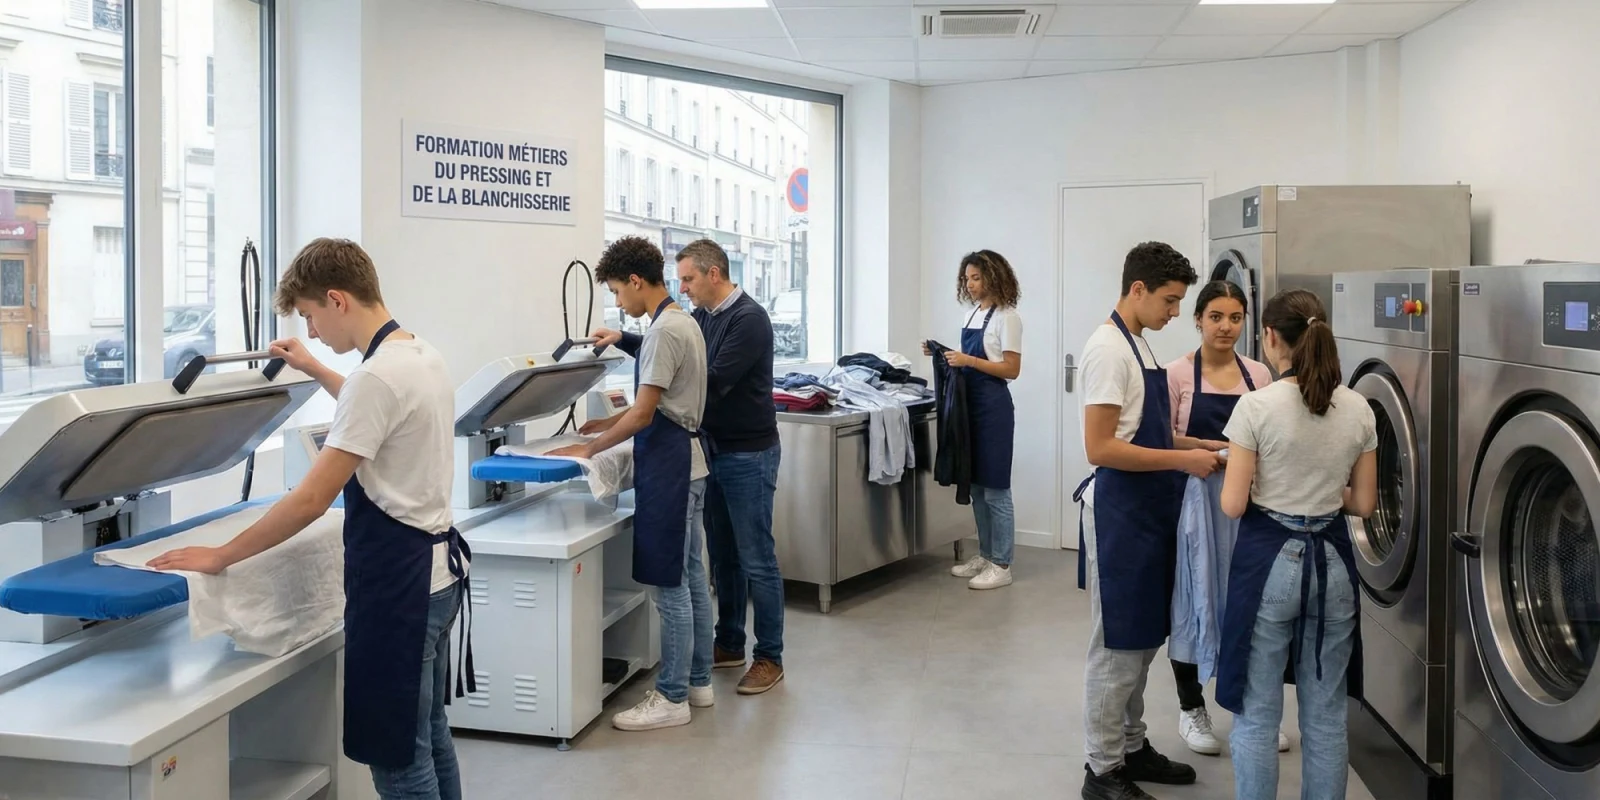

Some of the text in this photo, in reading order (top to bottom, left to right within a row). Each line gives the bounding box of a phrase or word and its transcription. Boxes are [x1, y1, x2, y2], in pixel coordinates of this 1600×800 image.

[416, 134, 568, 166] FORMATION MÉTIERS
[435, 161, 552, 187] DU PRESSING ET
[413, 185, 570, 212] DE LA BLANCHISSERIE
